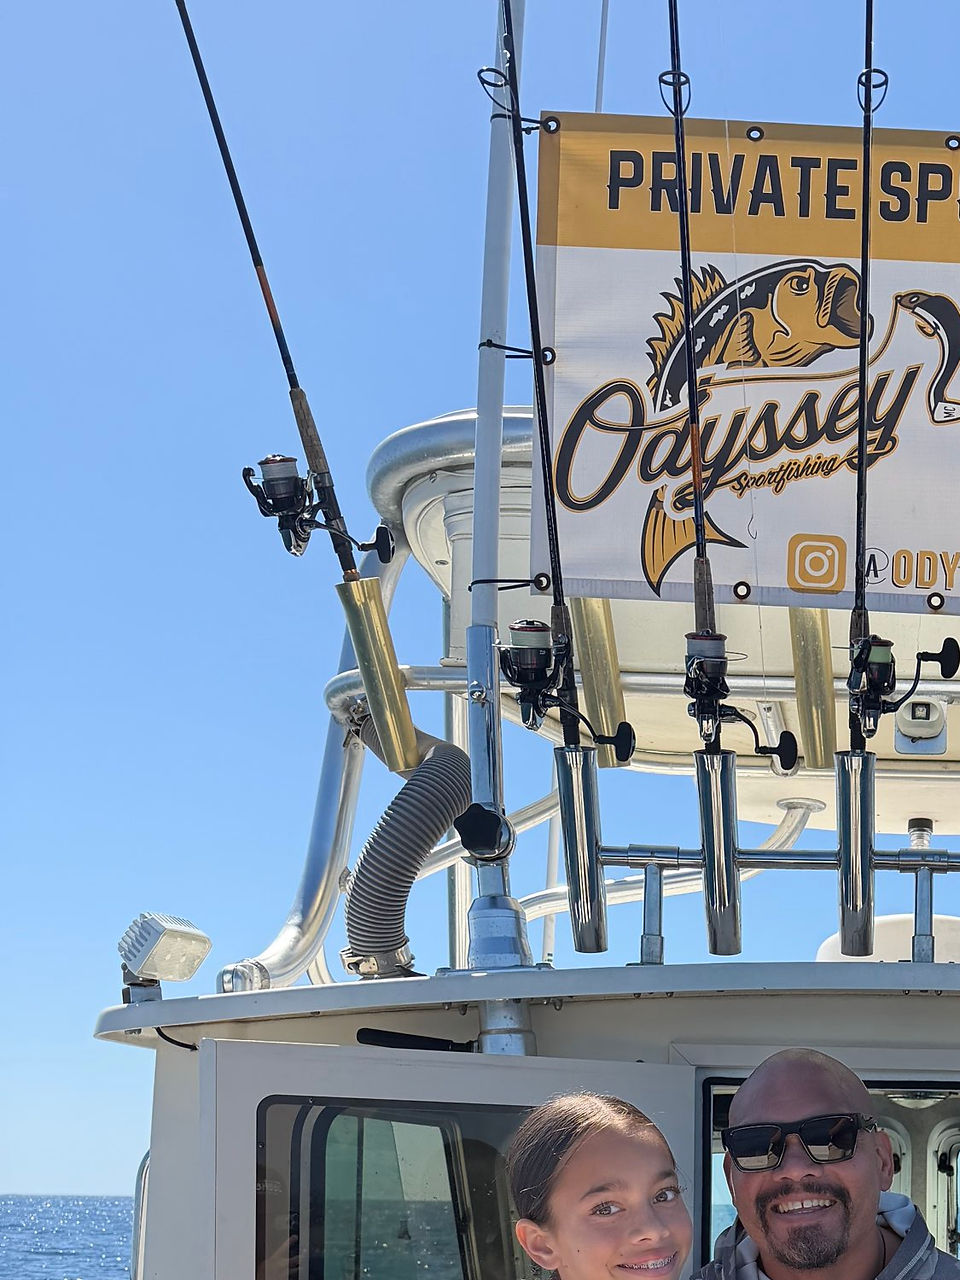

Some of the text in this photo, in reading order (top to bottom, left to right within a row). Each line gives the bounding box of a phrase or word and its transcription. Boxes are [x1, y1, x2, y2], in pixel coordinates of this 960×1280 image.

[606, 150, 859, 221] PRIVATE
[553, 363, 924, 514] Odyssey
[730, 453, 842, 498] Sportfishing
